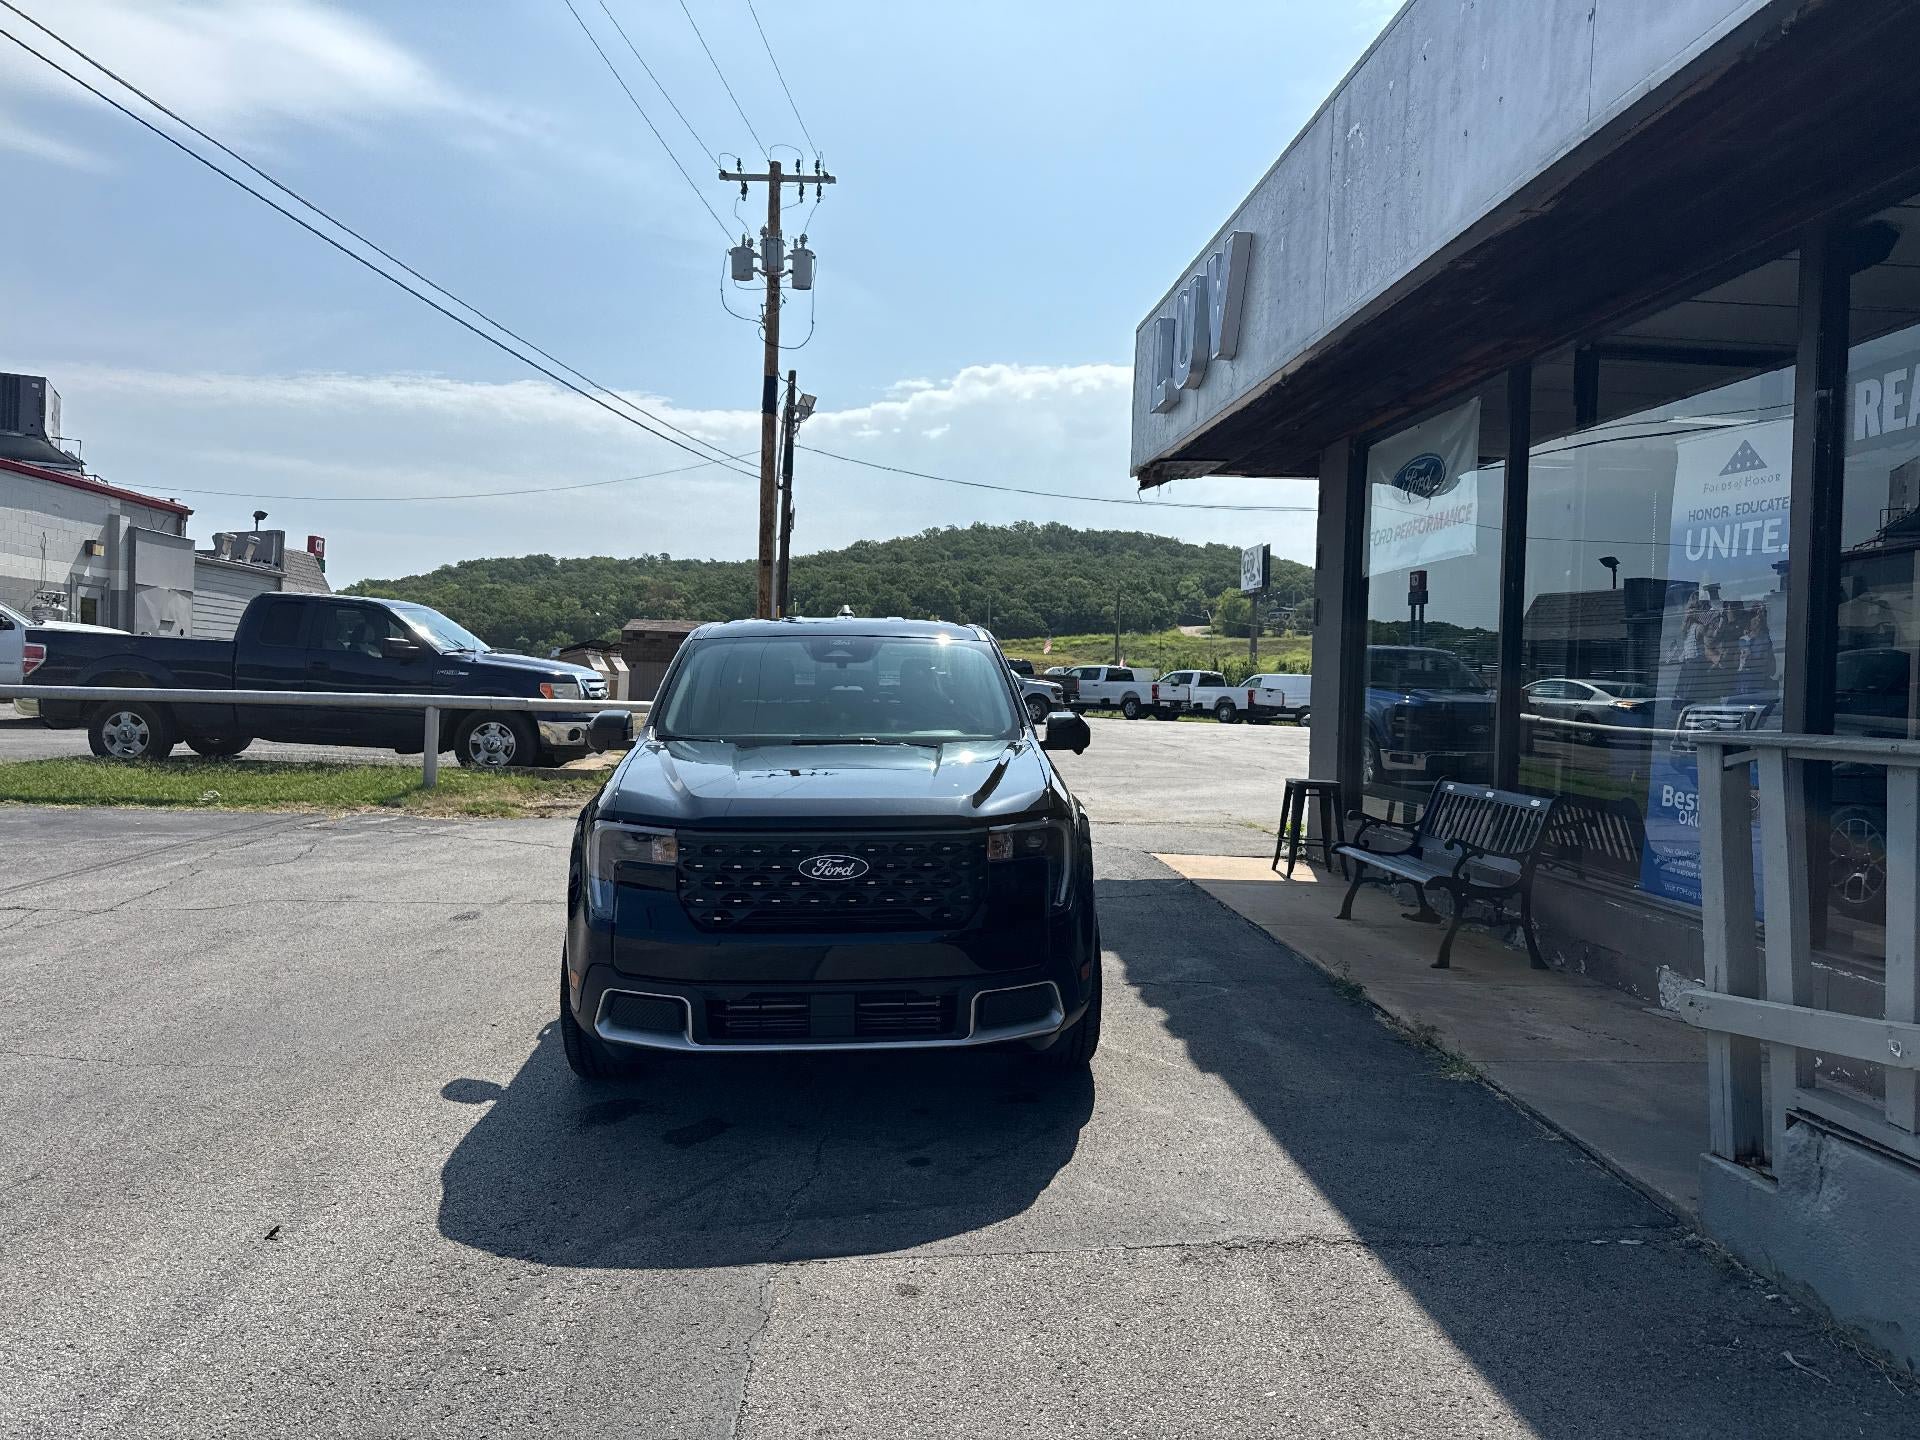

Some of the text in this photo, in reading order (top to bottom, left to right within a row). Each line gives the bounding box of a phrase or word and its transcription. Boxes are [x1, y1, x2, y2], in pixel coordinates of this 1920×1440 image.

[1403, 463, 1435, 493] Ford
[1394, 502, 1474, 542] PERFORMANCE
[1685, 518, 1789, 561] UNITE.
[812, 859, 855, 876] Ford
